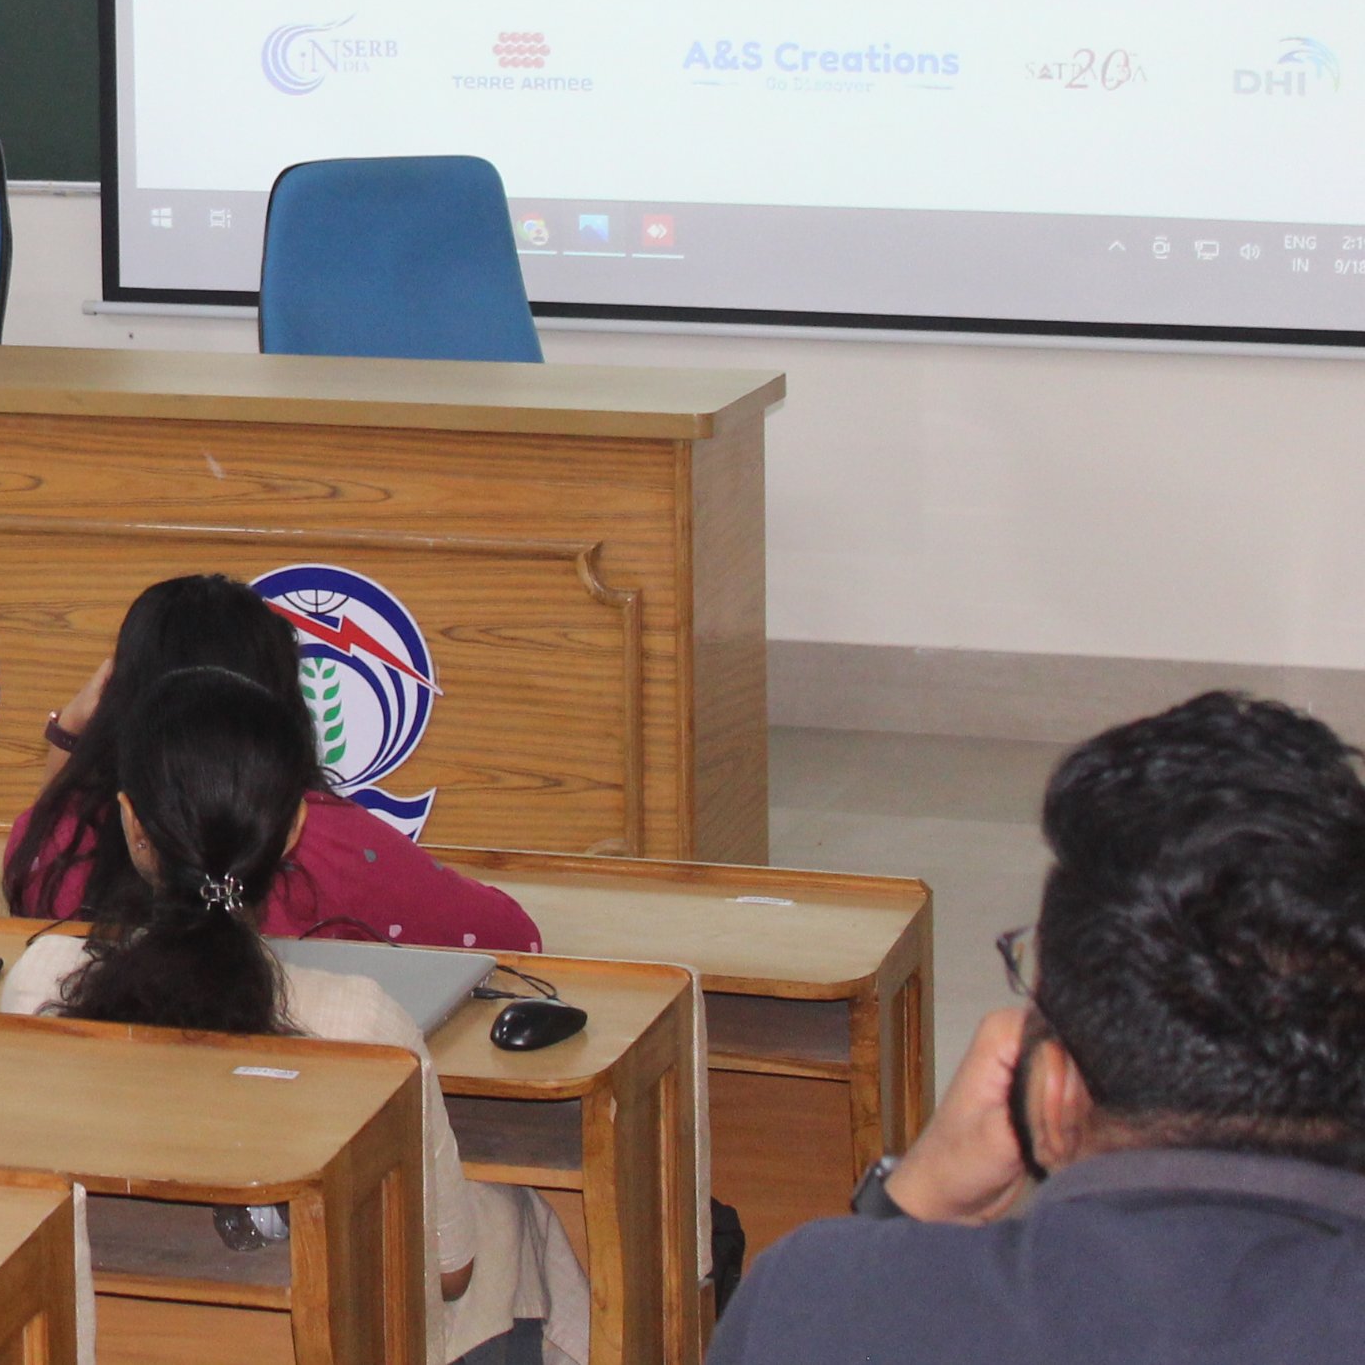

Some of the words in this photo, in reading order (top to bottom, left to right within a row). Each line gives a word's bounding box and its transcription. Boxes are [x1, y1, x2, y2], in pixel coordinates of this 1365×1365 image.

[682, 39, 763, 72] A&S
[774, 41, 960, 76] Creations
[1232, 69, 1308, 97] DHI
[1284, 234, 1317, 251] ENG
[1341, 235, 1365, 251] 2:1
[1292, 258, 1309, 273] IN
